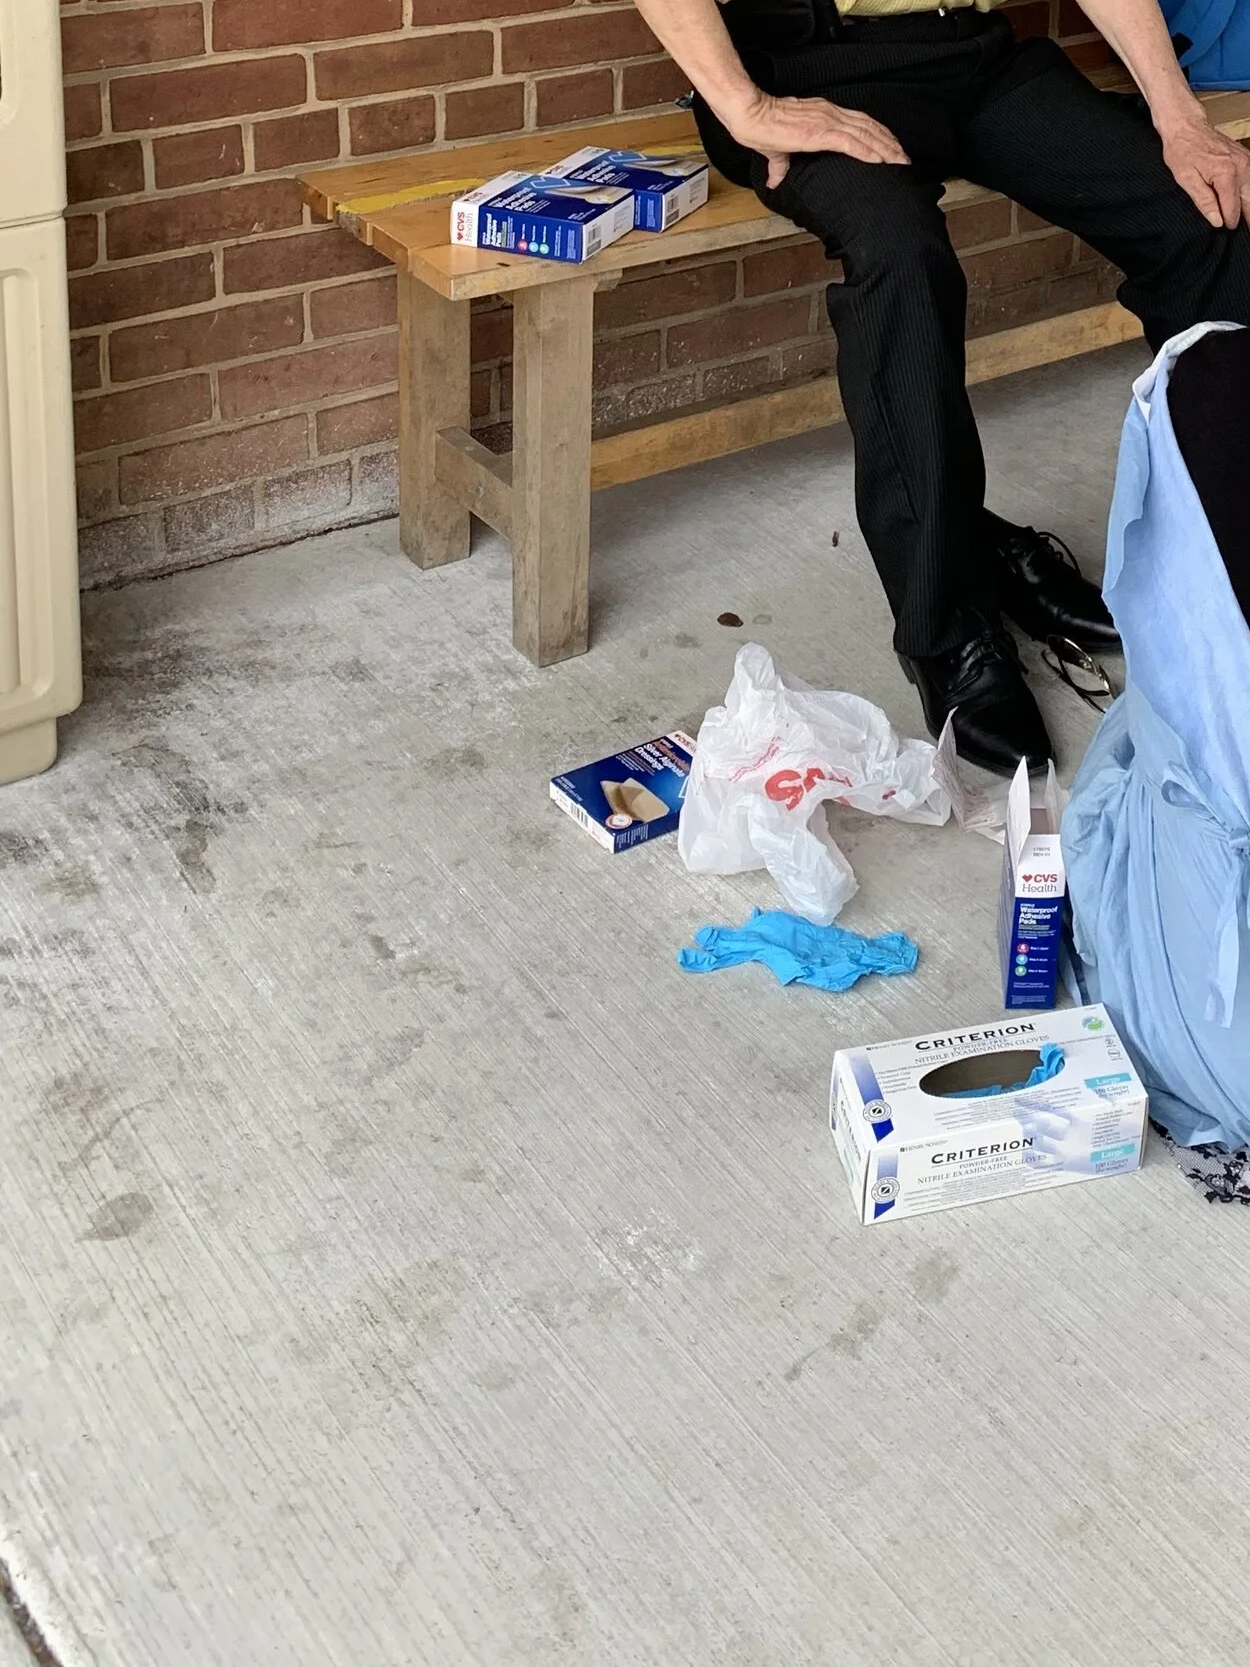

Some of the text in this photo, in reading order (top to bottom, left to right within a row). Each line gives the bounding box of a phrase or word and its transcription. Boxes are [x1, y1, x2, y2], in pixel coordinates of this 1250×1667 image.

[457, 211, 465, 232] CVS
[1022, 884, 1057, 893] Health
[1034, 874, 1058, 883] CVS
[1020, 906, 1058, 914] Waterproof
[915, 1023, 1035, 1051] CRITERION
[915, 1034, 1050, 1065] NITRILE EXAMINATION GLOVES
[931, 1137, 1034, 1165] CRITERION
[918, 1154, 1047, 1185] NITRILE EXAMINATION GLOVES
[959, 1155, 1008, 1169] POWDER-FREE
